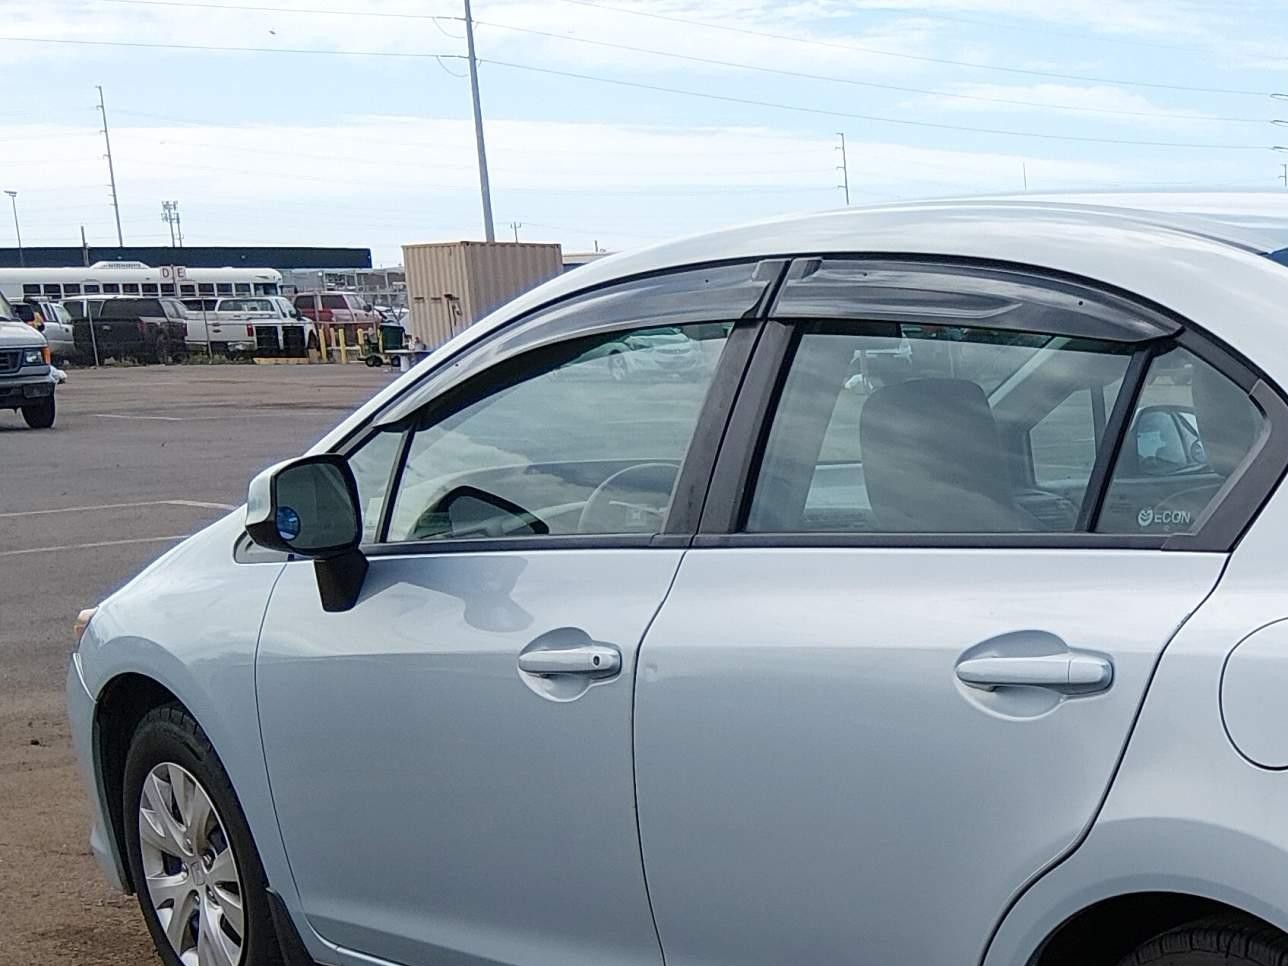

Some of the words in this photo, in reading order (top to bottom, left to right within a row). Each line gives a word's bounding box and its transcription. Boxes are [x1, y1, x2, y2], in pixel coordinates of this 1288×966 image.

[162, 267, 170, 278] D
[177, 267, 185, 278] E
[1154, 511, 1191, 523] ECON
